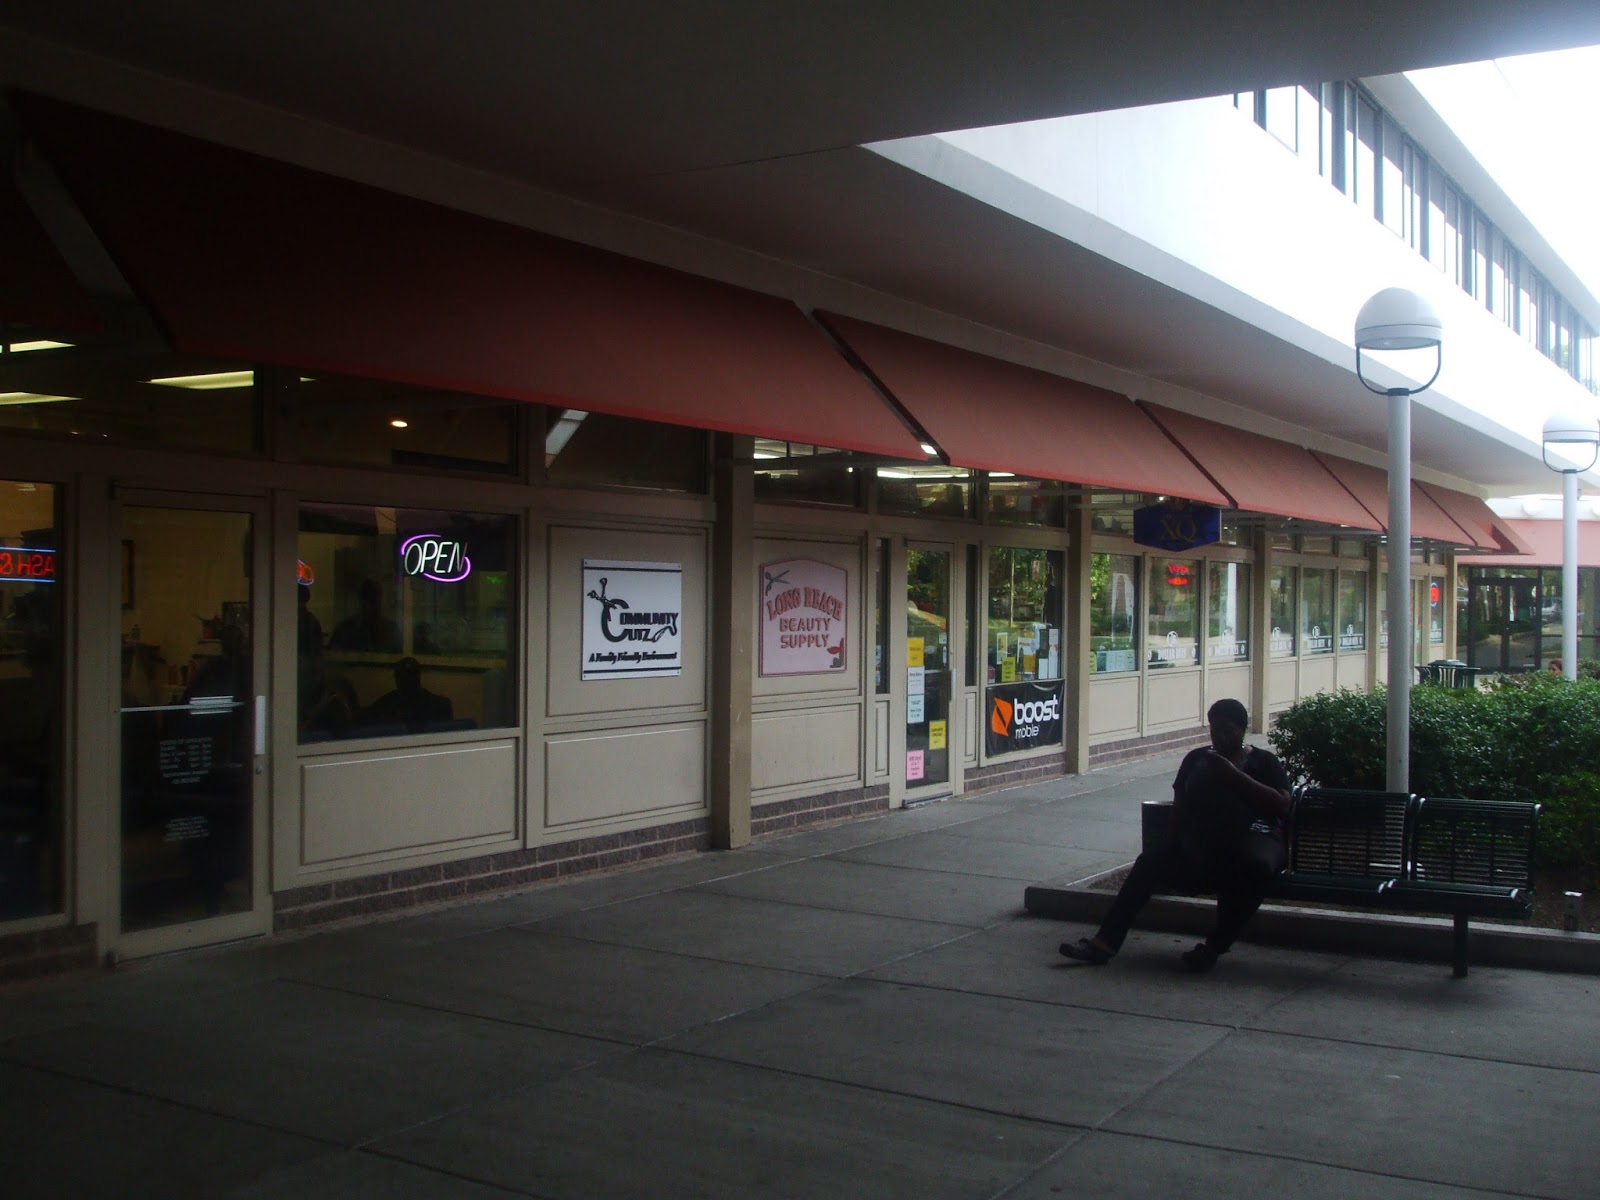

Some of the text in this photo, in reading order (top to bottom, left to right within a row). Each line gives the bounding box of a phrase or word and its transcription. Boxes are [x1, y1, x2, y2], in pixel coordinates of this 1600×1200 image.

[405, 540, 467, 575] OPEN
[767, 588, 801, 621] LONG
[780, 618, 831, 632] BEAUTY
[780, 634, 829, 649] SUPPLY
[1014, 694, 1060, 725] boost
[1015, 724, 1040, 739] mobile
